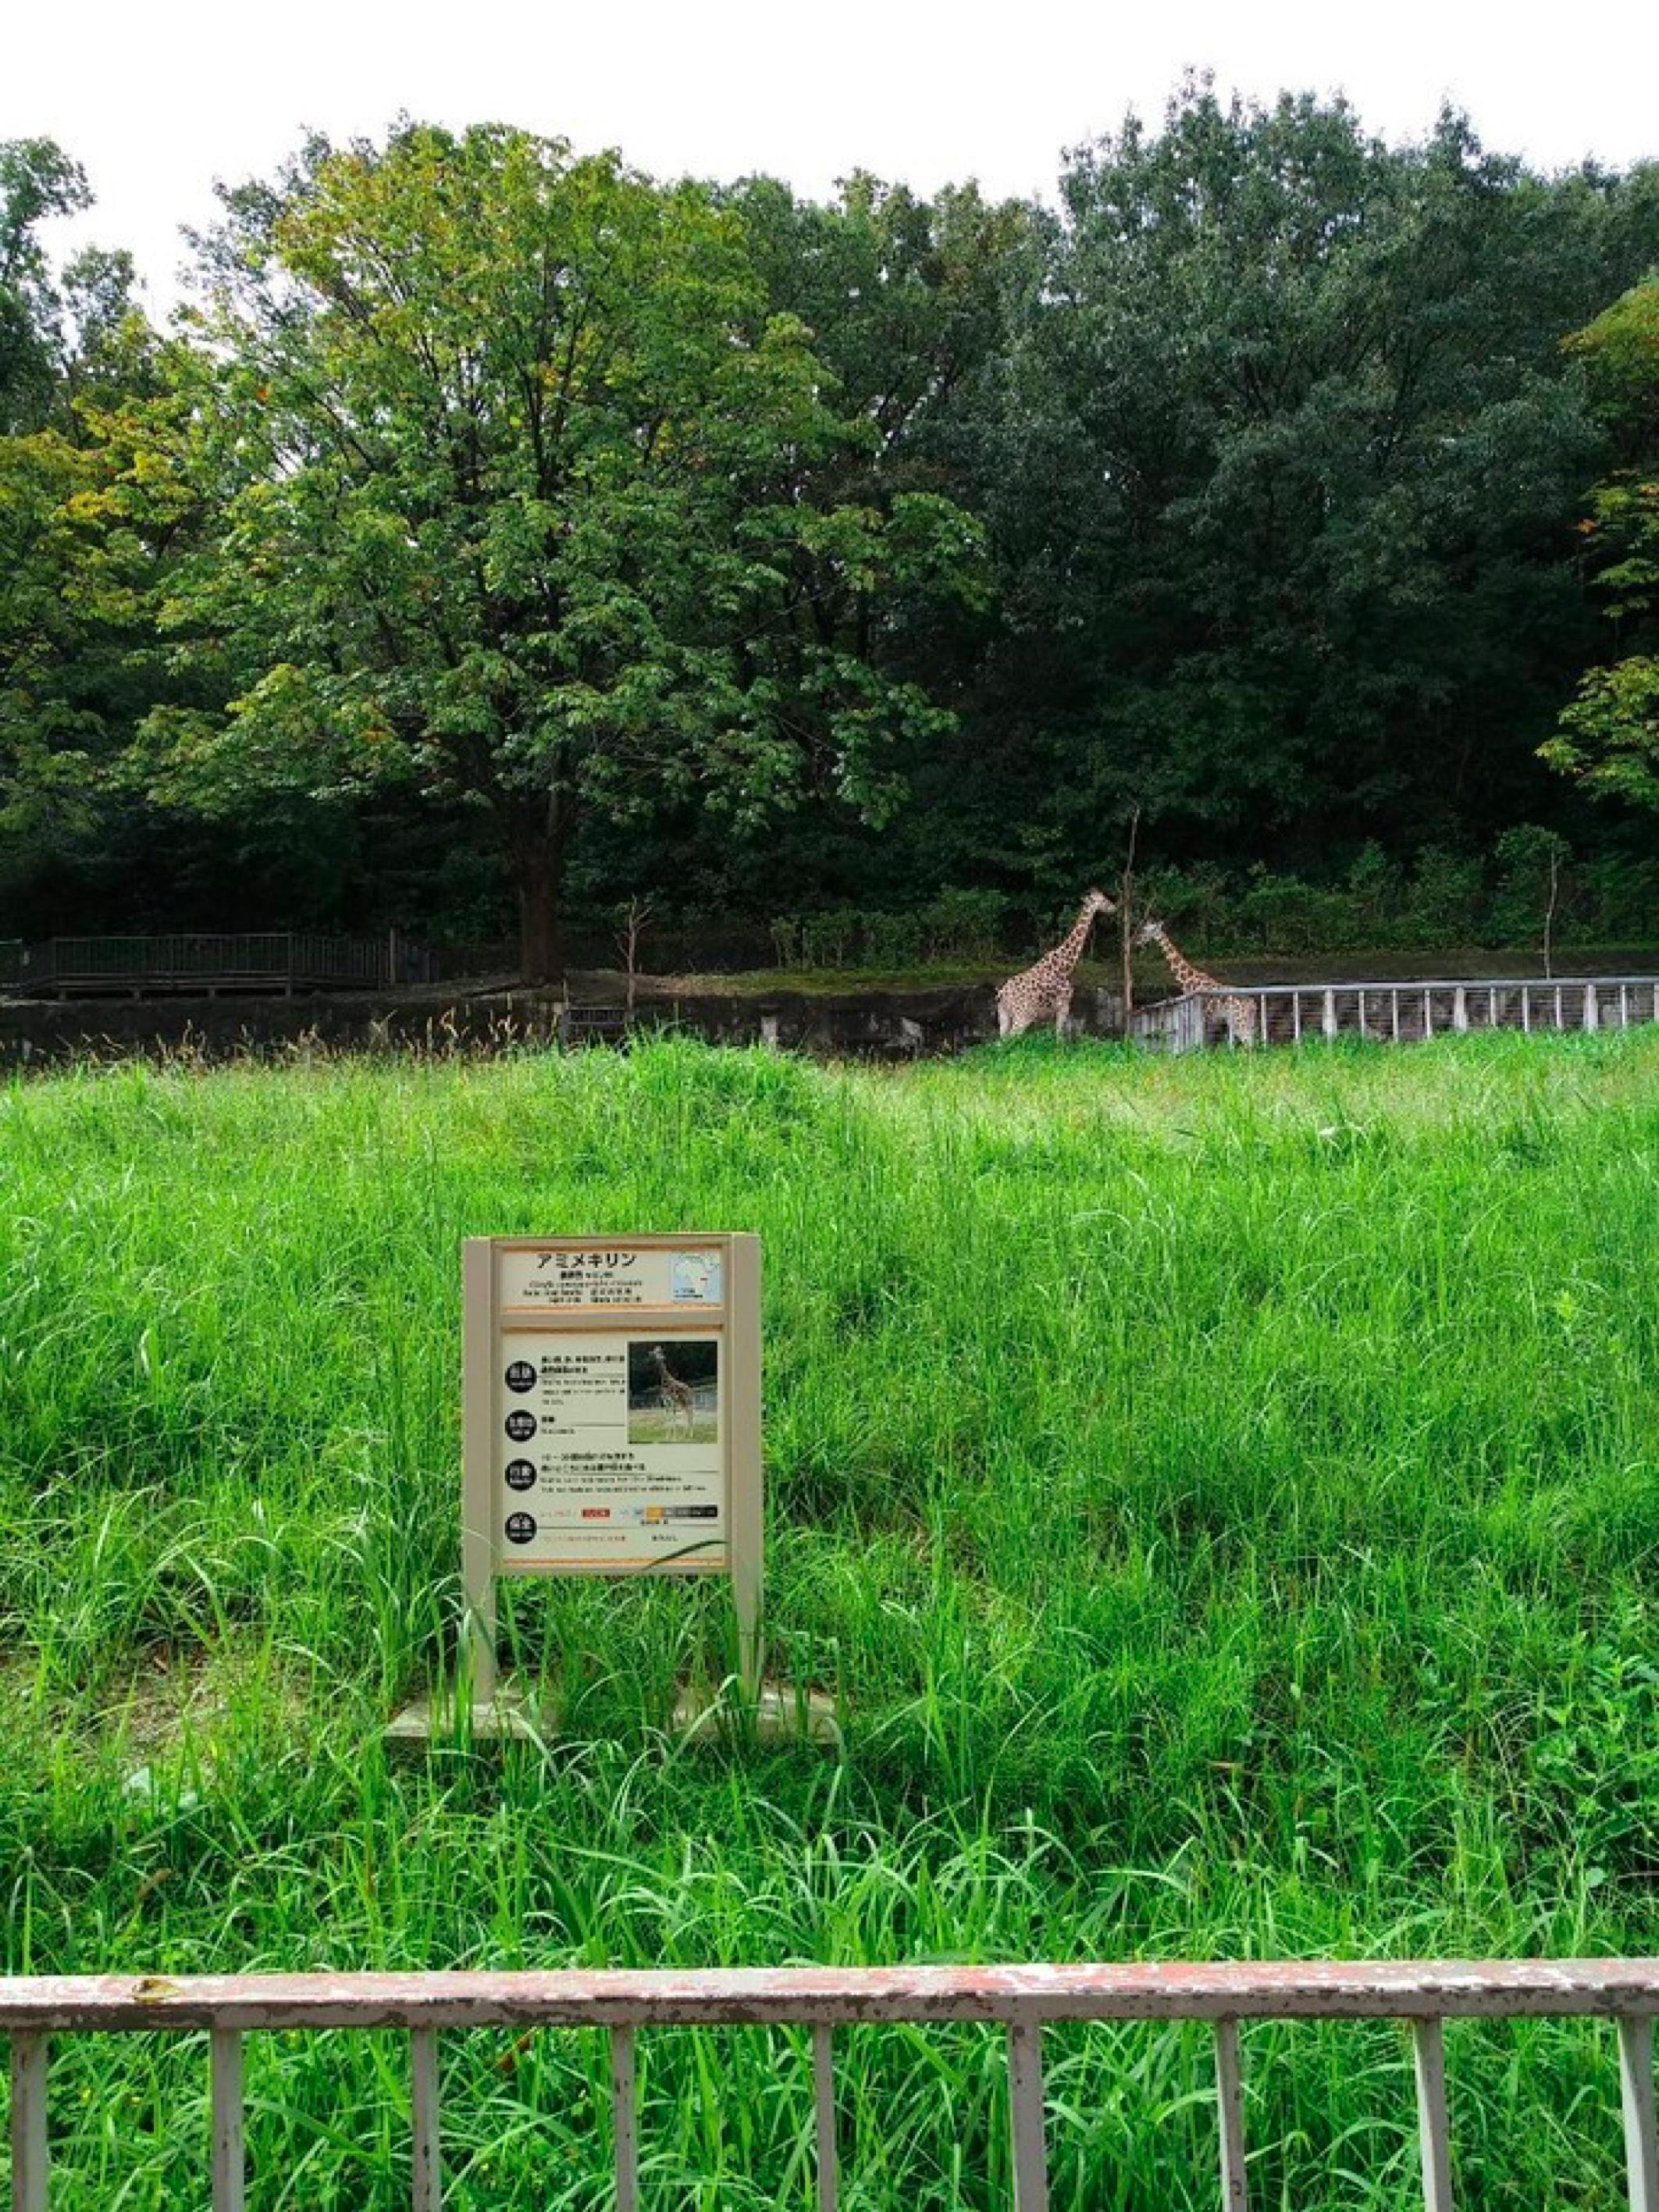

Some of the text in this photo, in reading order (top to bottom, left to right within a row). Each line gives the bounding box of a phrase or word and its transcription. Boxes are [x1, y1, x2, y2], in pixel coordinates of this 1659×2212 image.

[537, 1253, 637, 1268] アミメキリン
